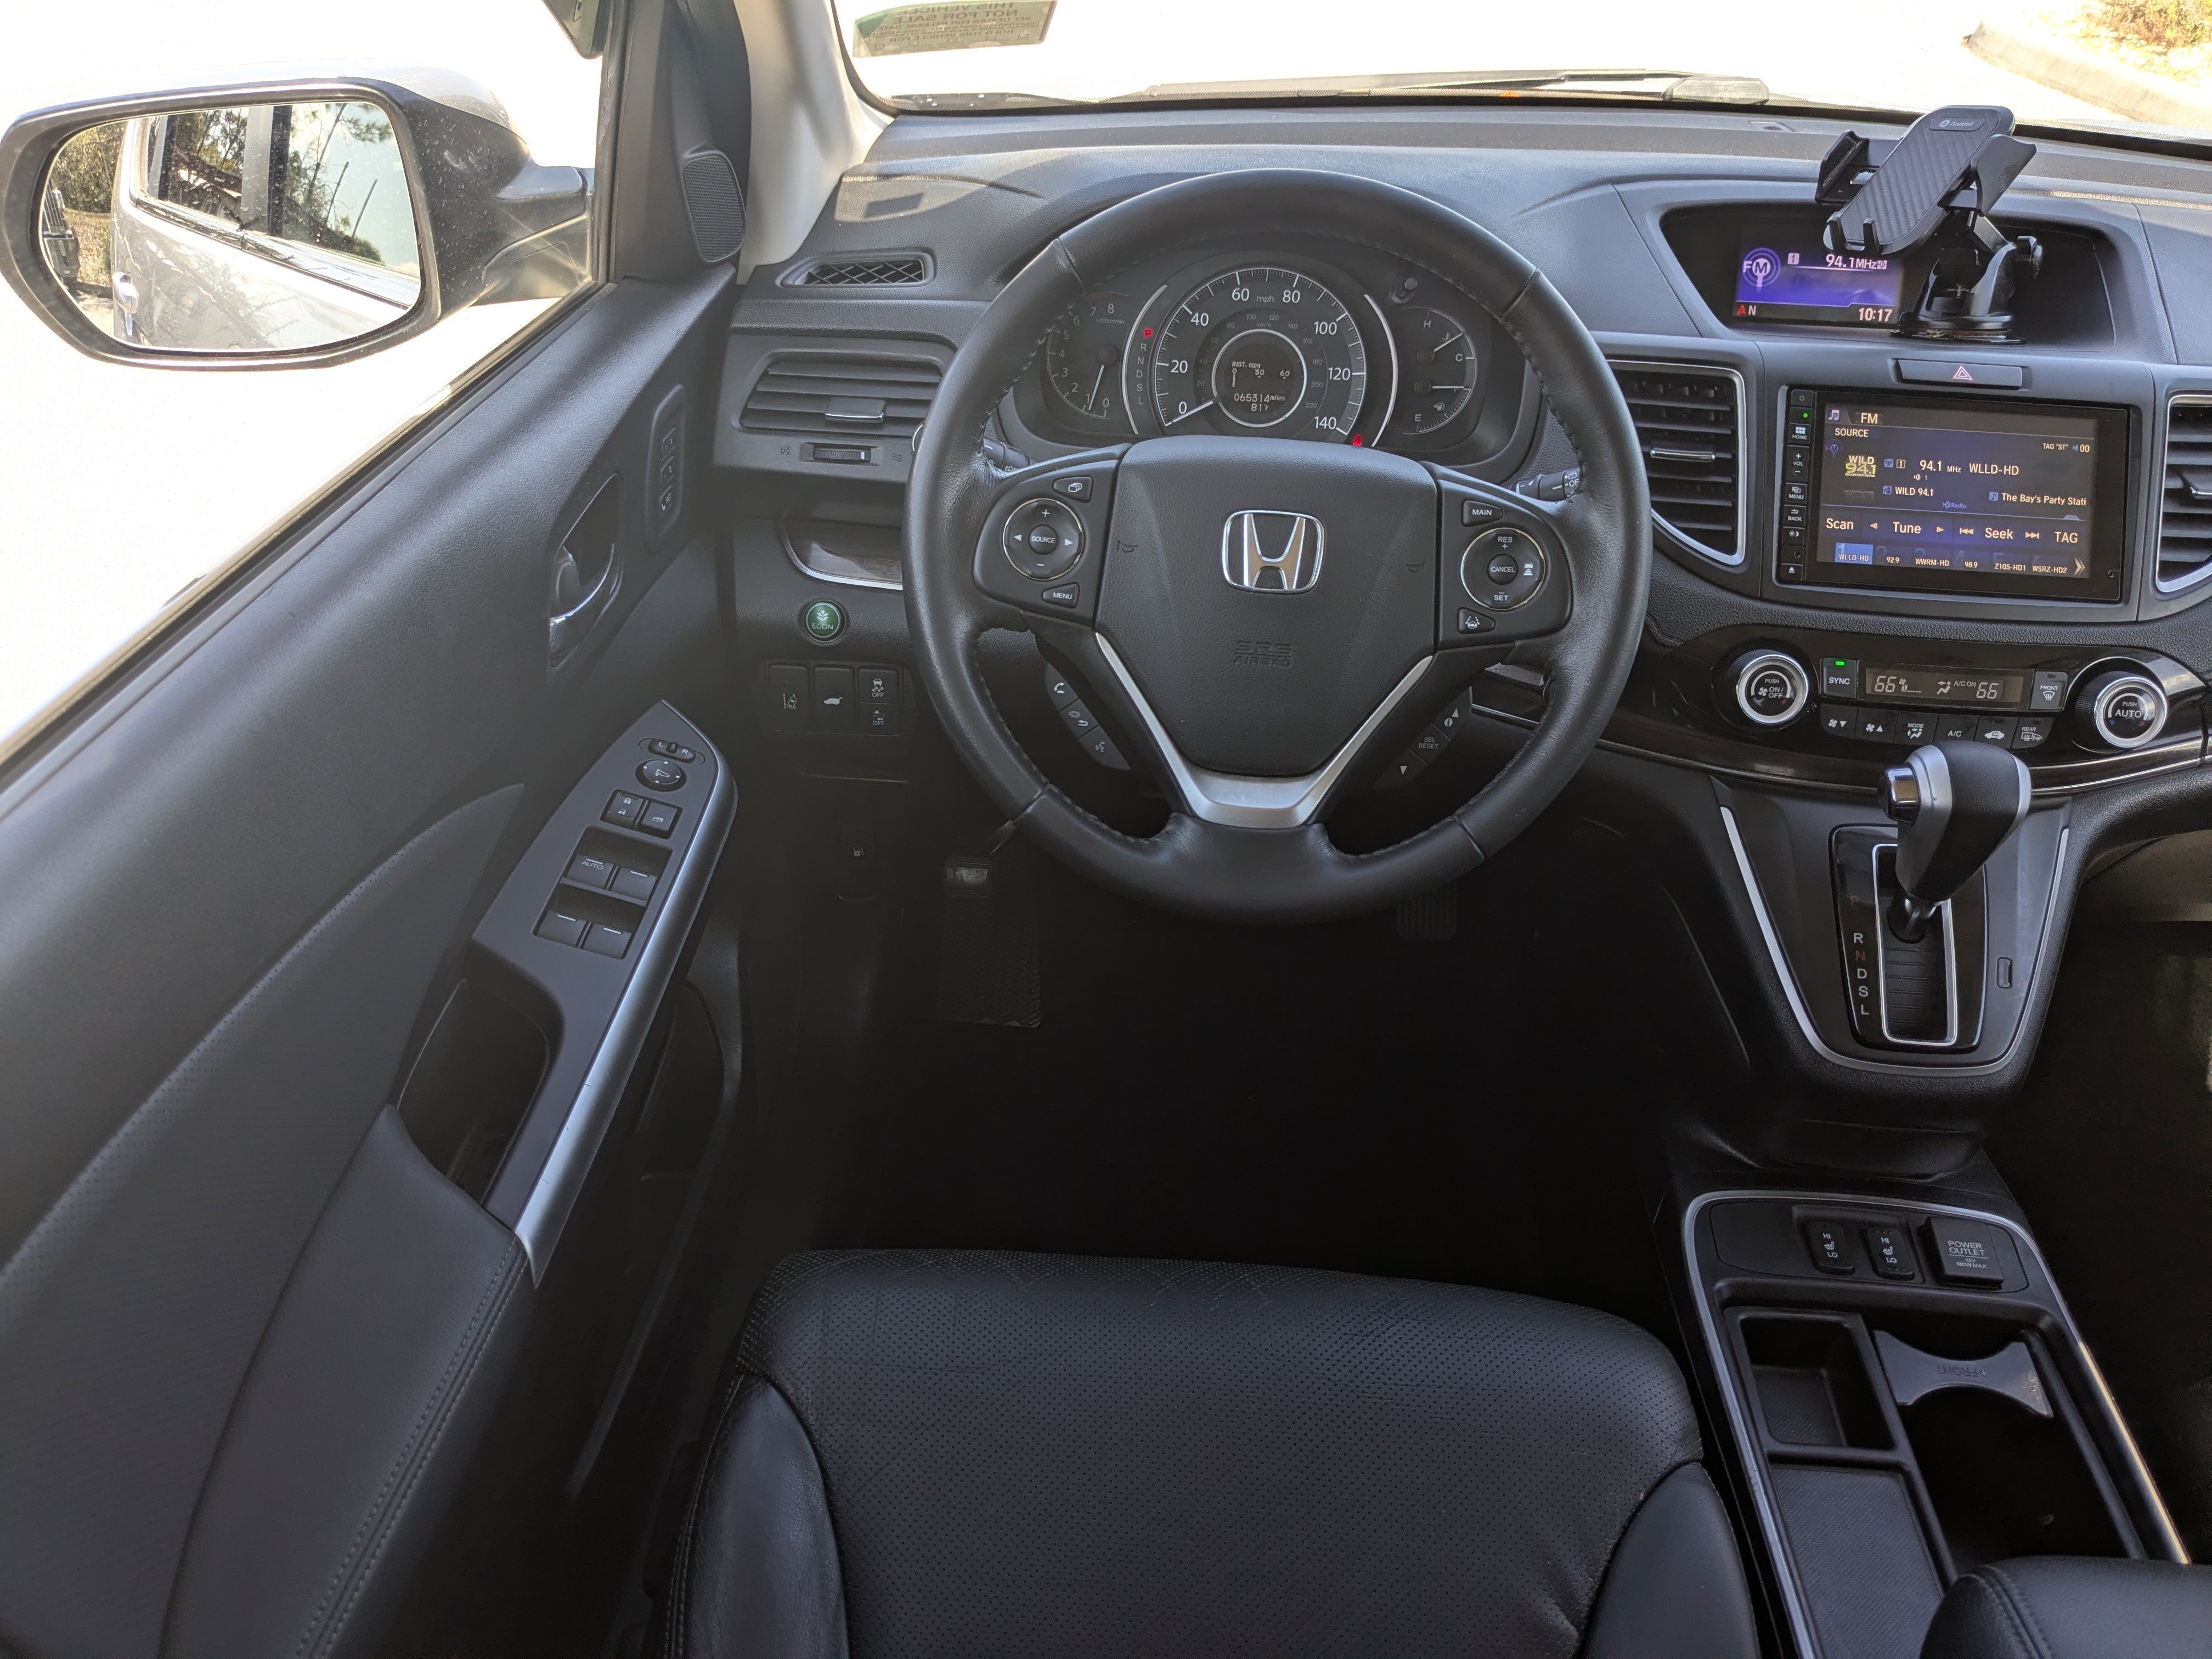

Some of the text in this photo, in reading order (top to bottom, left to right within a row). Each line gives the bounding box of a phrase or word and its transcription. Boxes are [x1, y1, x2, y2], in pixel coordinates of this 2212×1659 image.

[1232, 288, 1250, 301] 60
[1282, 290, 1300, 303] 80
[1091, 307, 1096, 317] 7
[1108, 304, 1114, 313] 8
[1749, 306, 1756, 315] N
[1190, 313, 1209, 326] 40
[1858, 308, 1892, 322] 10:17
[1073, 316, 1080, 325] 6
[1313, 321, 1338, 335] 100
[1063, 331, 1069, 340] 5
[1144, 330, 1152, 338] P
[1140, 343, 1147, 352] R
[1058, 349, 1064, 359] 4
[1455, 353, 1463, 362] C
[1138, 357, 1144, 365] N
[1171, 360, 1188, 374] 20
[1062, 368, 1068, 377] 3
[1327, 367, 1351, 381] 120
[1072, 382, 1078, 392] 2
[1137, 383, 1143, 392] S
[1086, 394, 1090, 403] 1
[1103, 398, 1109, 408] 0
[1139, 397, 1143, 405] L
[1178, 401, 1187, 414] 0
[1314, 416, 1337, 430] 140
[1414, 414, 1422, 422] E
[1860, 413, 1878, 424] FM
[1835, 428, 1869, 438] SOURCE
[2079, 444, 2090, 453] 00
[1848, 455, 1875, 466] WILD
[1845, 463, 1876, 475] 94.1
[1920, 460, 1942, 472] 94.1
[1968, 463, 2019, 476] WLLD-HD
[1895, 487, 1933, 496] WILD 94.1
[2001, 493, 2086, 507] The Bay's Party Stati
[1826, 518, 1854, 530] Scan
[1893, 522, 1921, 534] Tune
[1985, 527, 2013, 540] Seek
[2054, 532, 2078, 544] TAG
[1838, 554, 1869, 562] WLLD-HD
[1915, 558, 1950, 567] WWRM-HD
[1994, 563, 2026, 571] Z105-HD1
[2032, 565, 2067, 574] WSRZ-HD2
[811, 623, 834, 631] ECON
[1829, 676, 1850, 685] SYNC
[1874, 675, 1897, 693] 66
[1976, 682, 1999, 699] 66
[2114, 709, 2142, 718] AUTO
[582, 860, 604, 871] AUTO
[1853, 933, 1864, 944] R
[1855, 950, 1866, 961] N
[1857, 968, 1867, 979] D
[1858, 986, 1869, 997] S
[1860, 1005, 1869, 1015] L
[1948, 1240, 1983, 1249] POWER
[1949, 1247, 1985, 1256] OUTLET
